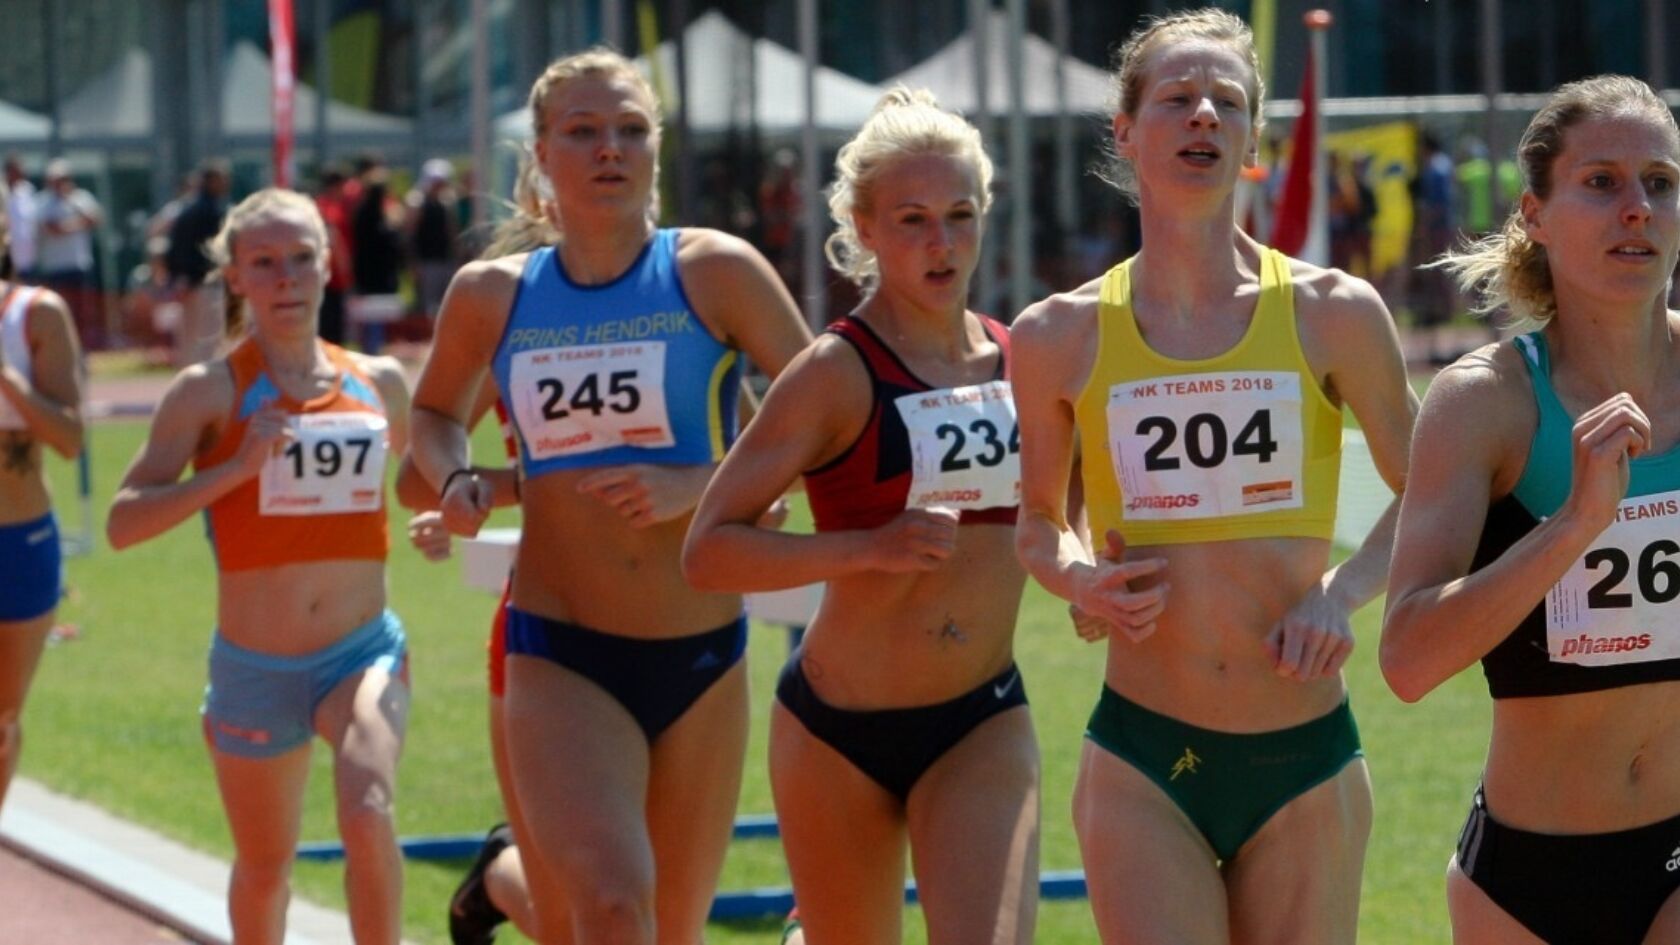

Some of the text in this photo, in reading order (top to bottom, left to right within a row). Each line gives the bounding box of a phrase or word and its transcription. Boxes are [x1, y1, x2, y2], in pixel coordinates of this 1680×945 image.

[508, 312, 693, 348] PRINS HENDRIK
[531, 354, 552, 365] NK
[557, 348, 604, 362] TEAMS
[537, 370, 641, 421] 245
[1133, 378, 1274, 398] NK TEAMS 2018
[285, 439, 372, 478] 197
[1135, 408, 1278, 472] 204
[1584, 539, 1680, 609] 26
[1561, 633, 1652, 656] phanos
